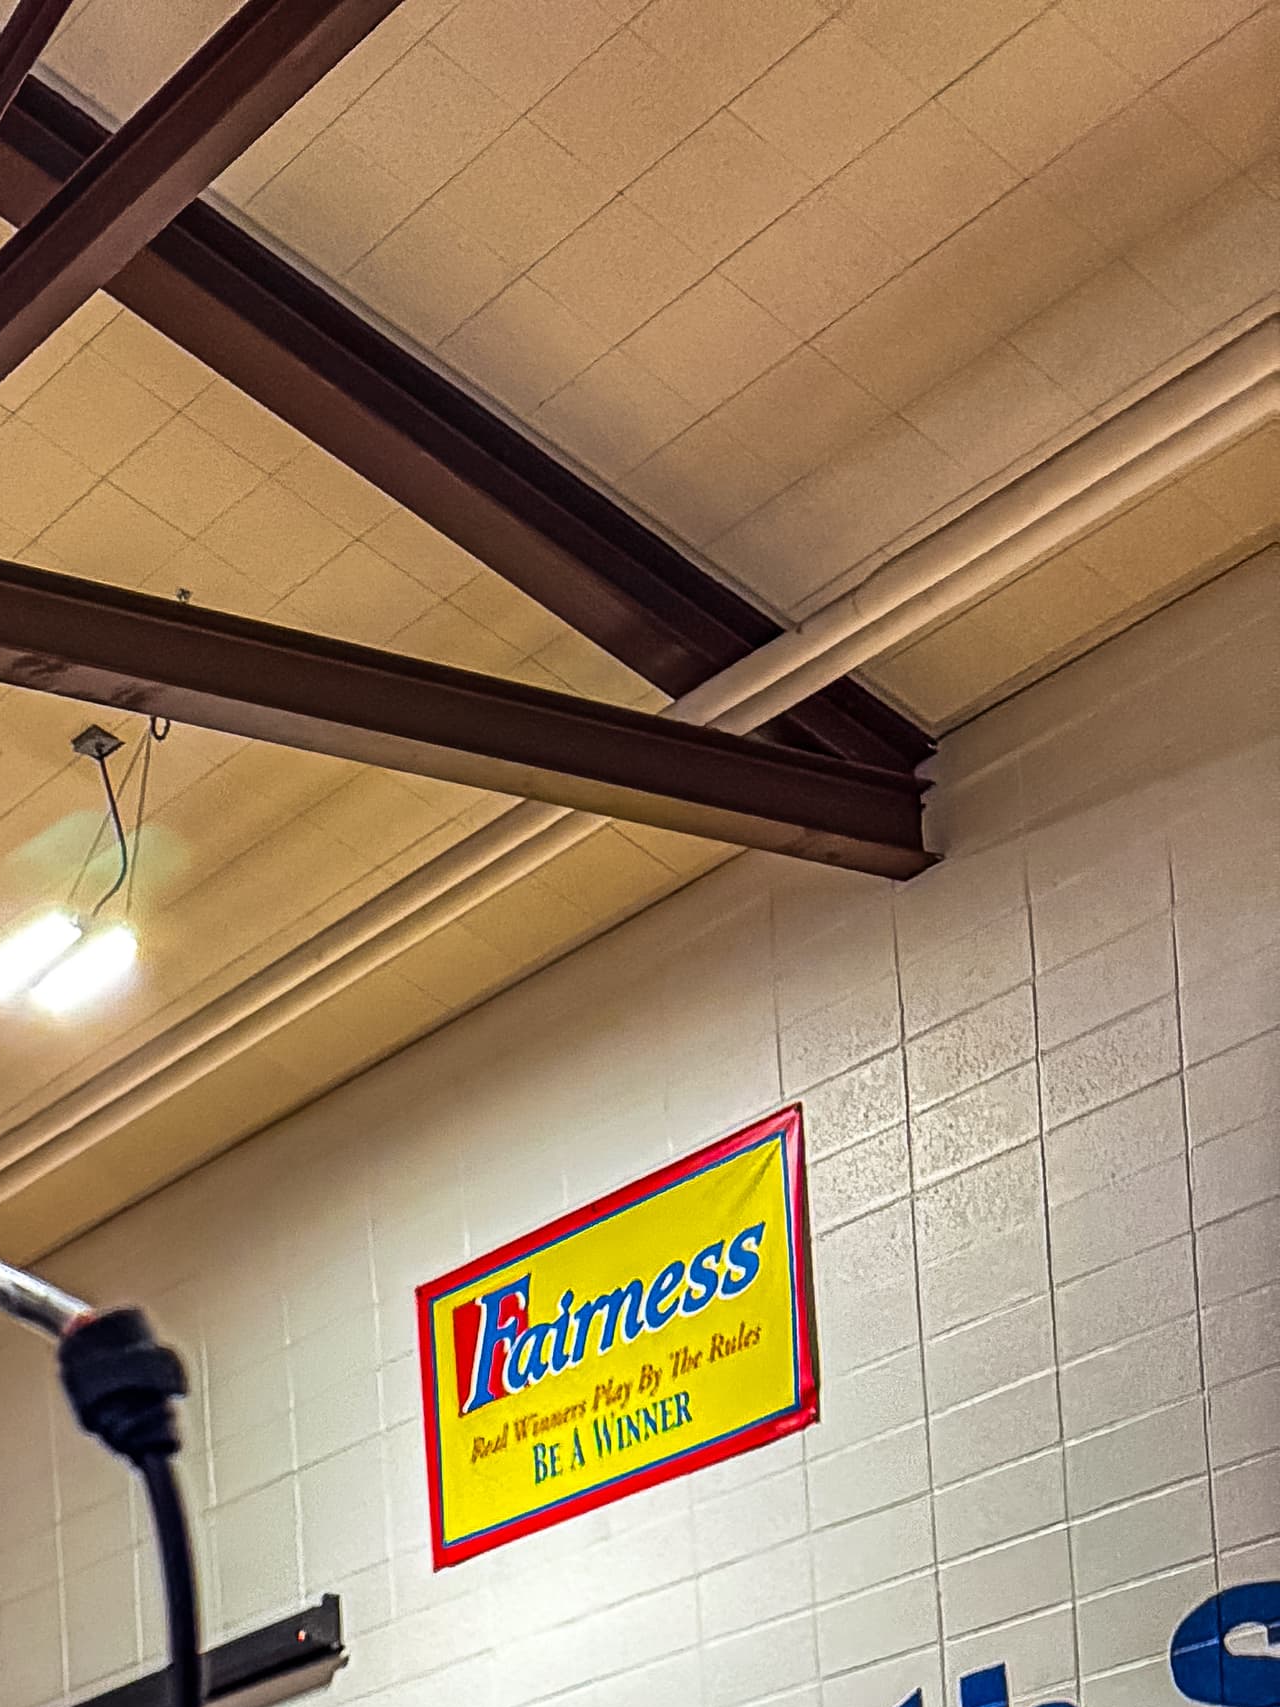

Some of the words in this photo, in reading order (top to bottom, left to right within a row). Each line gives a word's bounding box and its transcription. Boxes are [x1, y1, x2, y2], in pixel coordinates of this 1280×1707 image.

[462, 1222, 765, 1412] Fairness
[514, 1401, 587, 1442] Winners
[591, 1376, 634, 1412] Play
[639, 1364, 663, 1397] By
[671, 1346, 703, 1381] The
[708, 1321, 762, 1364] Rules
[533, 1442, 561, 1484] BE
[570, 1427, 586, 1470] A
[594, 1391, 693, 1459] WINNER
